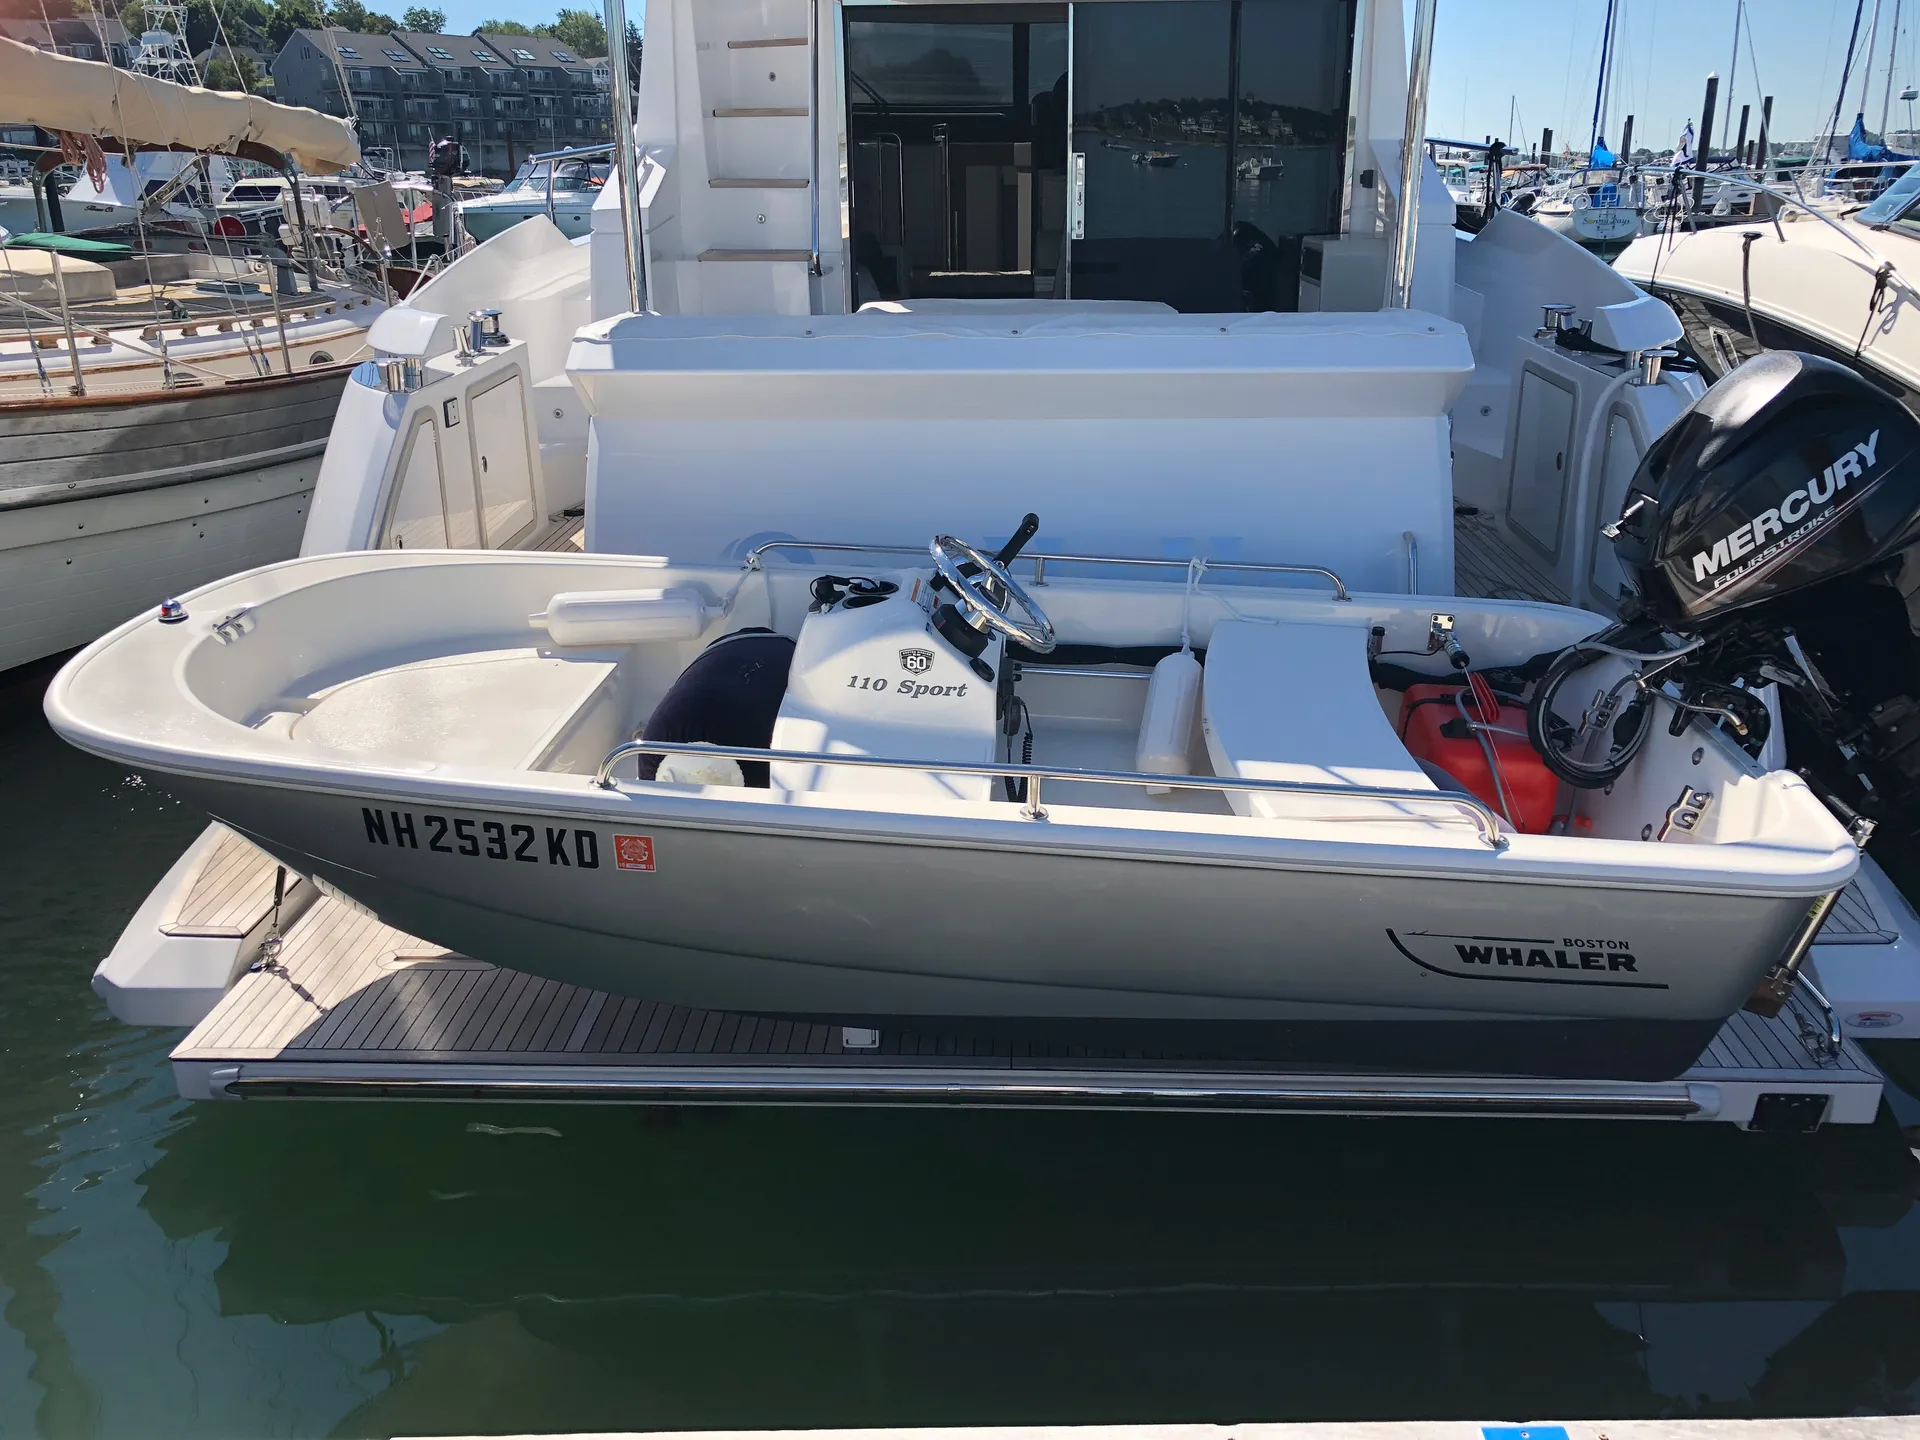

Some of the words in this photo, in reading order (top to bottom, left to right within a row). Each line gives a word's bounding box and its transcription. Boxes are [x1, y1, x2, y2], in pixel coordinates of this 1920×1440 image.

[1692, 429, 1880, 582] MERCURY
[1713, 505, 1836, 589] FOURSTROKE
[906, 655, 927, 670] 60
[846, 675, 888, 691] 110
[896, 679, 968, 698] Sport
[1563, 937, 1630, 950] BOSTON
[1454, 944, 1639, 972] WHALER
